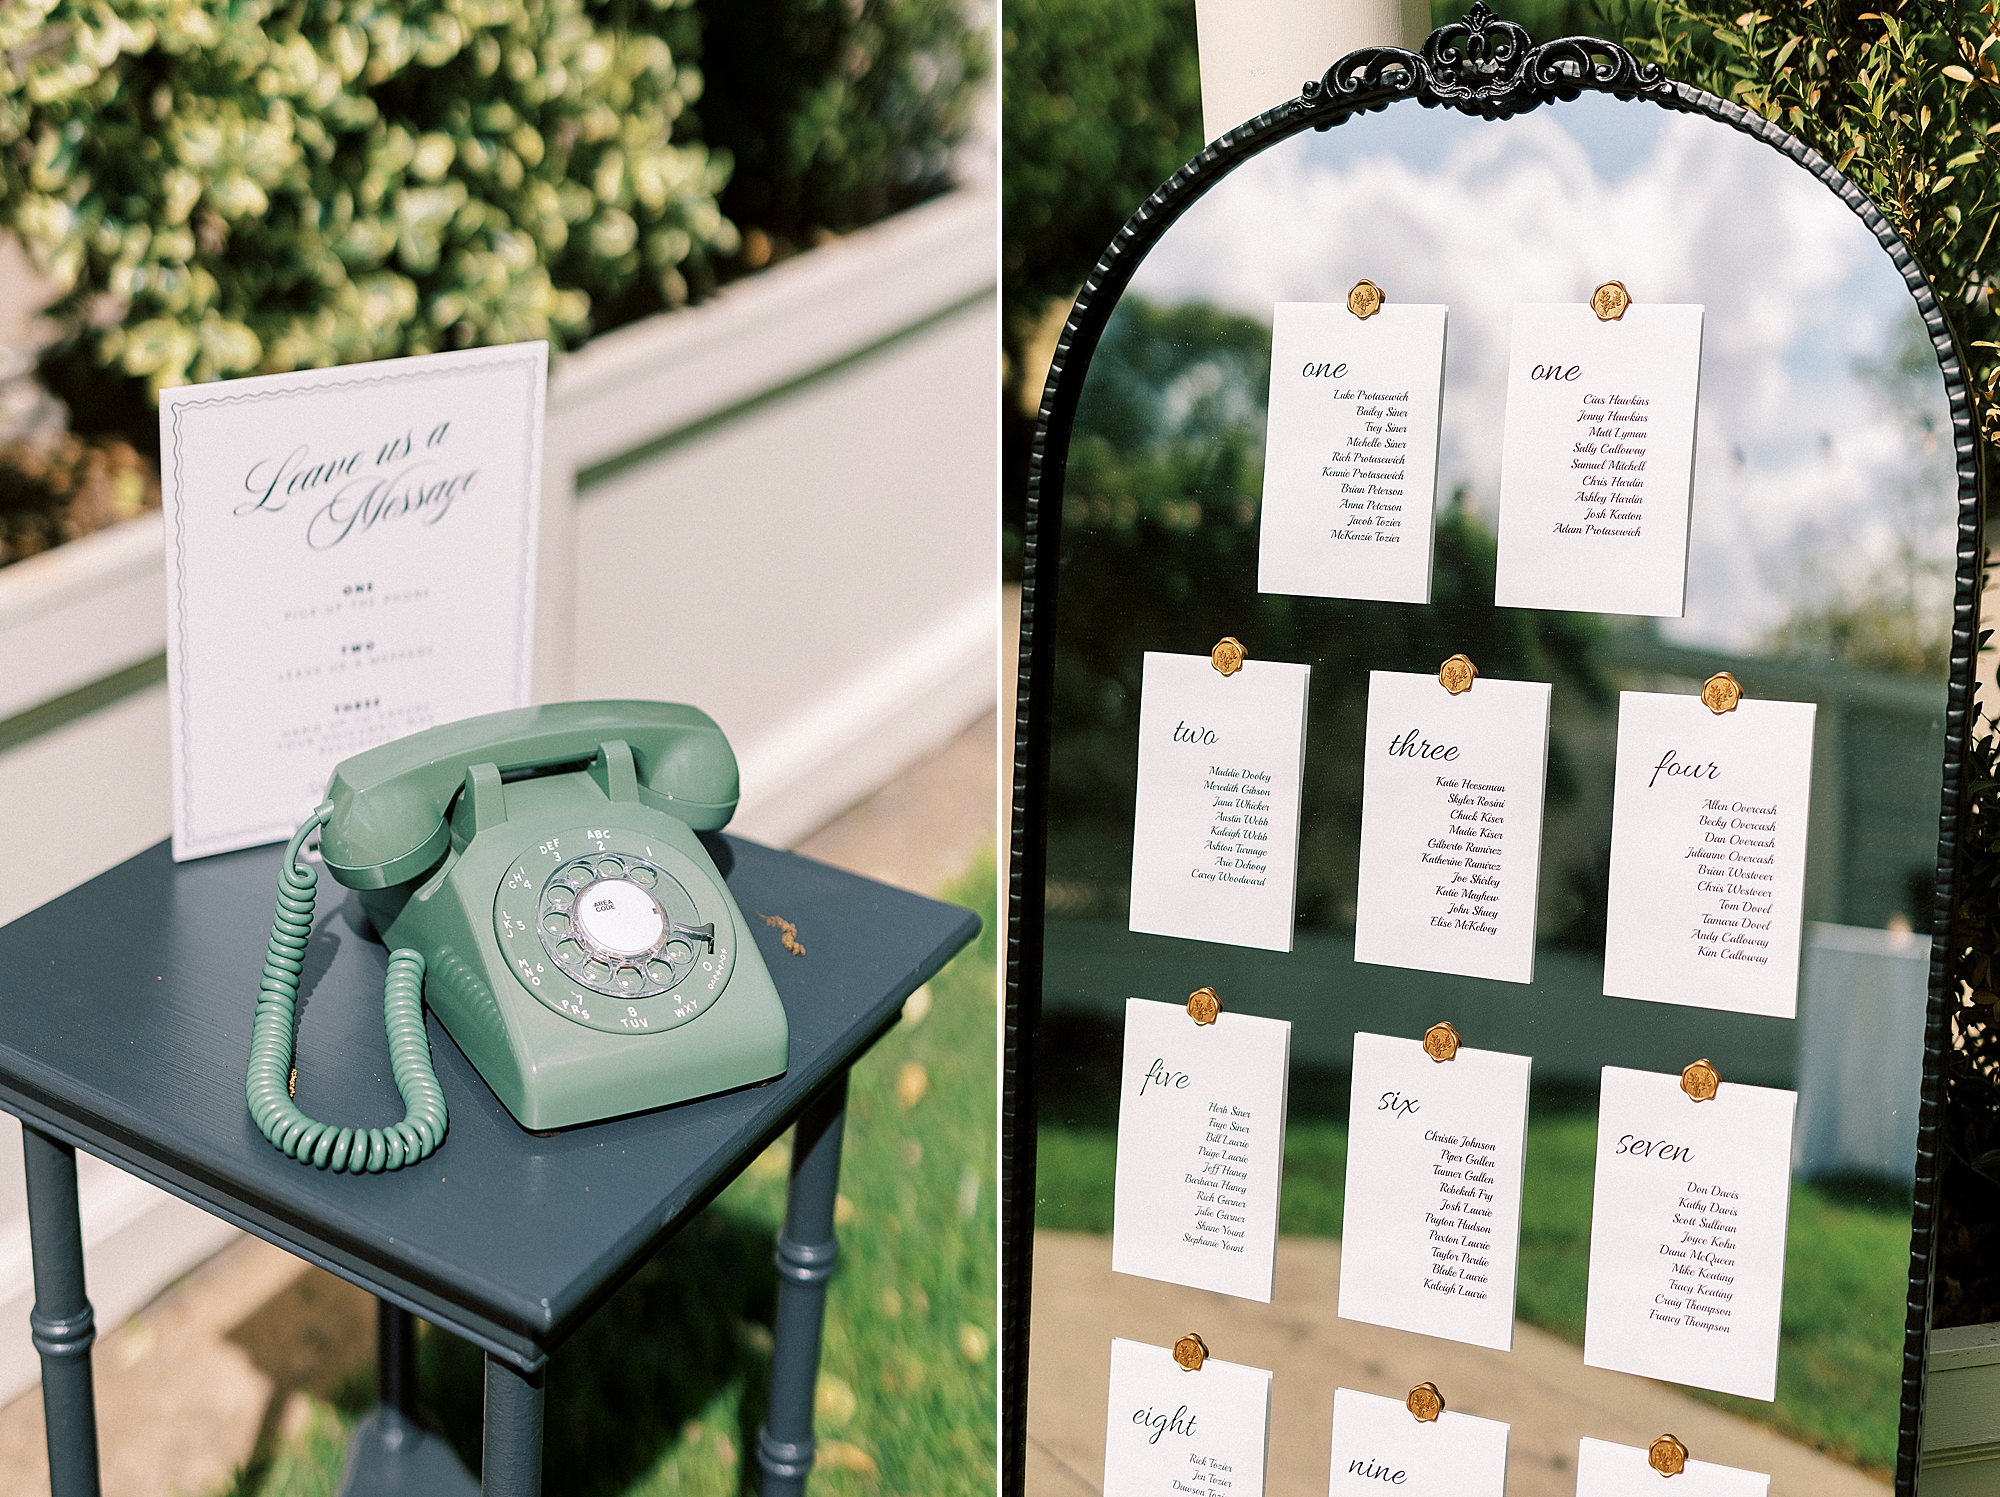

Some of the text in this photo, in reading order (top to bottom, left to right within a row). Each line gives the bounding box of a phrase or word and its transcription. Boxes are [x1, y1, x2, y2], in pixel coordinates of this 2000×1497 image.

[1302, 361, 1349, 379] one
[1530, 364, 1582, 381] one
[1356, 405, 1409, 419] Bailey Siner
[1576, 409, 1649, 424] Jenny Hawkins
[1364, 421, 1408, 435] Trey Siner
[1588, 426, 1647, 441] Matt Lyman
[1346, 436, 1407, 449] Michelle Siner
[1572, 441, 1647, 458] Sally Calloway
[1331, 451, 1352, 463] Rich
[233, 420, 451, 517] Leave us a
[1340, 482, 1404, 496] Brian Peterson
[1582, 474, 1644, 488] Chris Hardin
[307, 459, 479, 551] Message
[1338, 498, 1403, 512] Anna Peterson
[1574, 491, 1643, 506] Ashley Hardin
[1346, 514, 1402, 528] Jacob Tozier
[1583, 507, 1642, 521] Josh Keaton
[1330, 528, 1401, 543] McKenzie Tozier
[1552, 522, 1583, 535] Adam
[342, 582, 373, 596] ONE
[341, 641, 375, 655] TWO
[334, 698, 380, 713] THREE
[1173, 719, 1219, 746] two
[1388, 728, 1461, 762] three
[1208, 765, 1272, 784] Maddie Dooley
[1648, 749, 1721, 788] four
[1203, 779, 1271, 797] Meredith Gibson
[1435, 775, 1507, 793] Katie Heeseman
[1447, 792, 1507, 809] Skyler Rosini
[1701, 798, 1778, 816] Allen Overcash
[1449, 808, 1505, 824] Chuck Kiser
[1699, 814, 1777, 832] Becky Overcash
[586, 829, 611, 840] ABC
[1210, 825, 1268, 842] Kaleigh Webb
[539, 838, 560, 855] DEF
[596, 840, 606, 852] 2
[552, 851, 562, 862] 3
[1421, 852, 1502, 872] Katherine Ramirez
[1684, 846, 1775, 865] Julianne Overcash
[1191, 868, 1267, 887] Carey Woodward
[1697, 863, 1725, 877] Brian
[523, 879, 532, 890] 4
[1450, 871, 1501, 889] Joe Shirley
[1435, 885, 1500, 903] Katie Mayhew
[593, 899, 614, 908] AREA
[595, 904, 616, 913] CODE
[1718, 898, 1774, 915] Tom Dovel
[516, 920, 526, 931] 5
[1701, 913, 1773, 931] Tamara Dovel
[1690, 928, 1770, 950] Andy Calloway
[1697, 945, 1769, 966] Kim Calloway
[518, 958, 541, 986] MNO
[536, 962, 544, 973] 6
[575, 994, 583, 1006] 7
[673, 994, 682, 1004] 9
[561, 999, 590, 1020] PRS
[627, 1006, 638, 1017] 8
[674, 999, 699, 1018] WXY
[620, 1017, 649, 1028] TUV
[1140, 1057, 1190, 1096] five
[1377, 1091, 1420, 1119] six
[1229, 1120, 1250, 1134] Siner
[1424, 1129, 1497, 1152] Christie Johnson
[1615, 1133, 1695, 1163] seven
[1198, 1145, 1249, 1164] Paige Laurie
[1440, 1148, 1496, 1168] Piper Gallen
[1196, 1190, 1215, 1203] Rich
[1439, 1181, 1477, 1198] Rebekah
[1687, 1181, 1739, 1200] Don Davis
[1439, 1198, 1493, 1218] Josh Laurie
[1678, 1196, 1738, 1217] Kathy Davis
[1425, 1211, 1492, 1234] Payton Hudson
[1672, 1212, 1737, 1234] Scott Sullivan
[1182, 1232, 1245, 1254] Stephanie Yount
[1428, 1229, 1491, 1251] Paxton Laurie
[1659, 1244, 1735, 1267] Dana McQueen
[1671, 1262, 1735, 1286] Mike Keating
[1423, 1277, 1488, 1300] Kaleigh Laurie
[1668, 1278, 1734, 1302] Tracy Keating
[1654, 1293, 1732, 1317] Craig Thompson
[1132, 1404, 1198, 1445] eight
[1189, 1452, 1233, 1473] Rick Tozier
[1348, 1458, 1408, 1485] nine
[1208, 1472, 1232, 1488] Tozier
